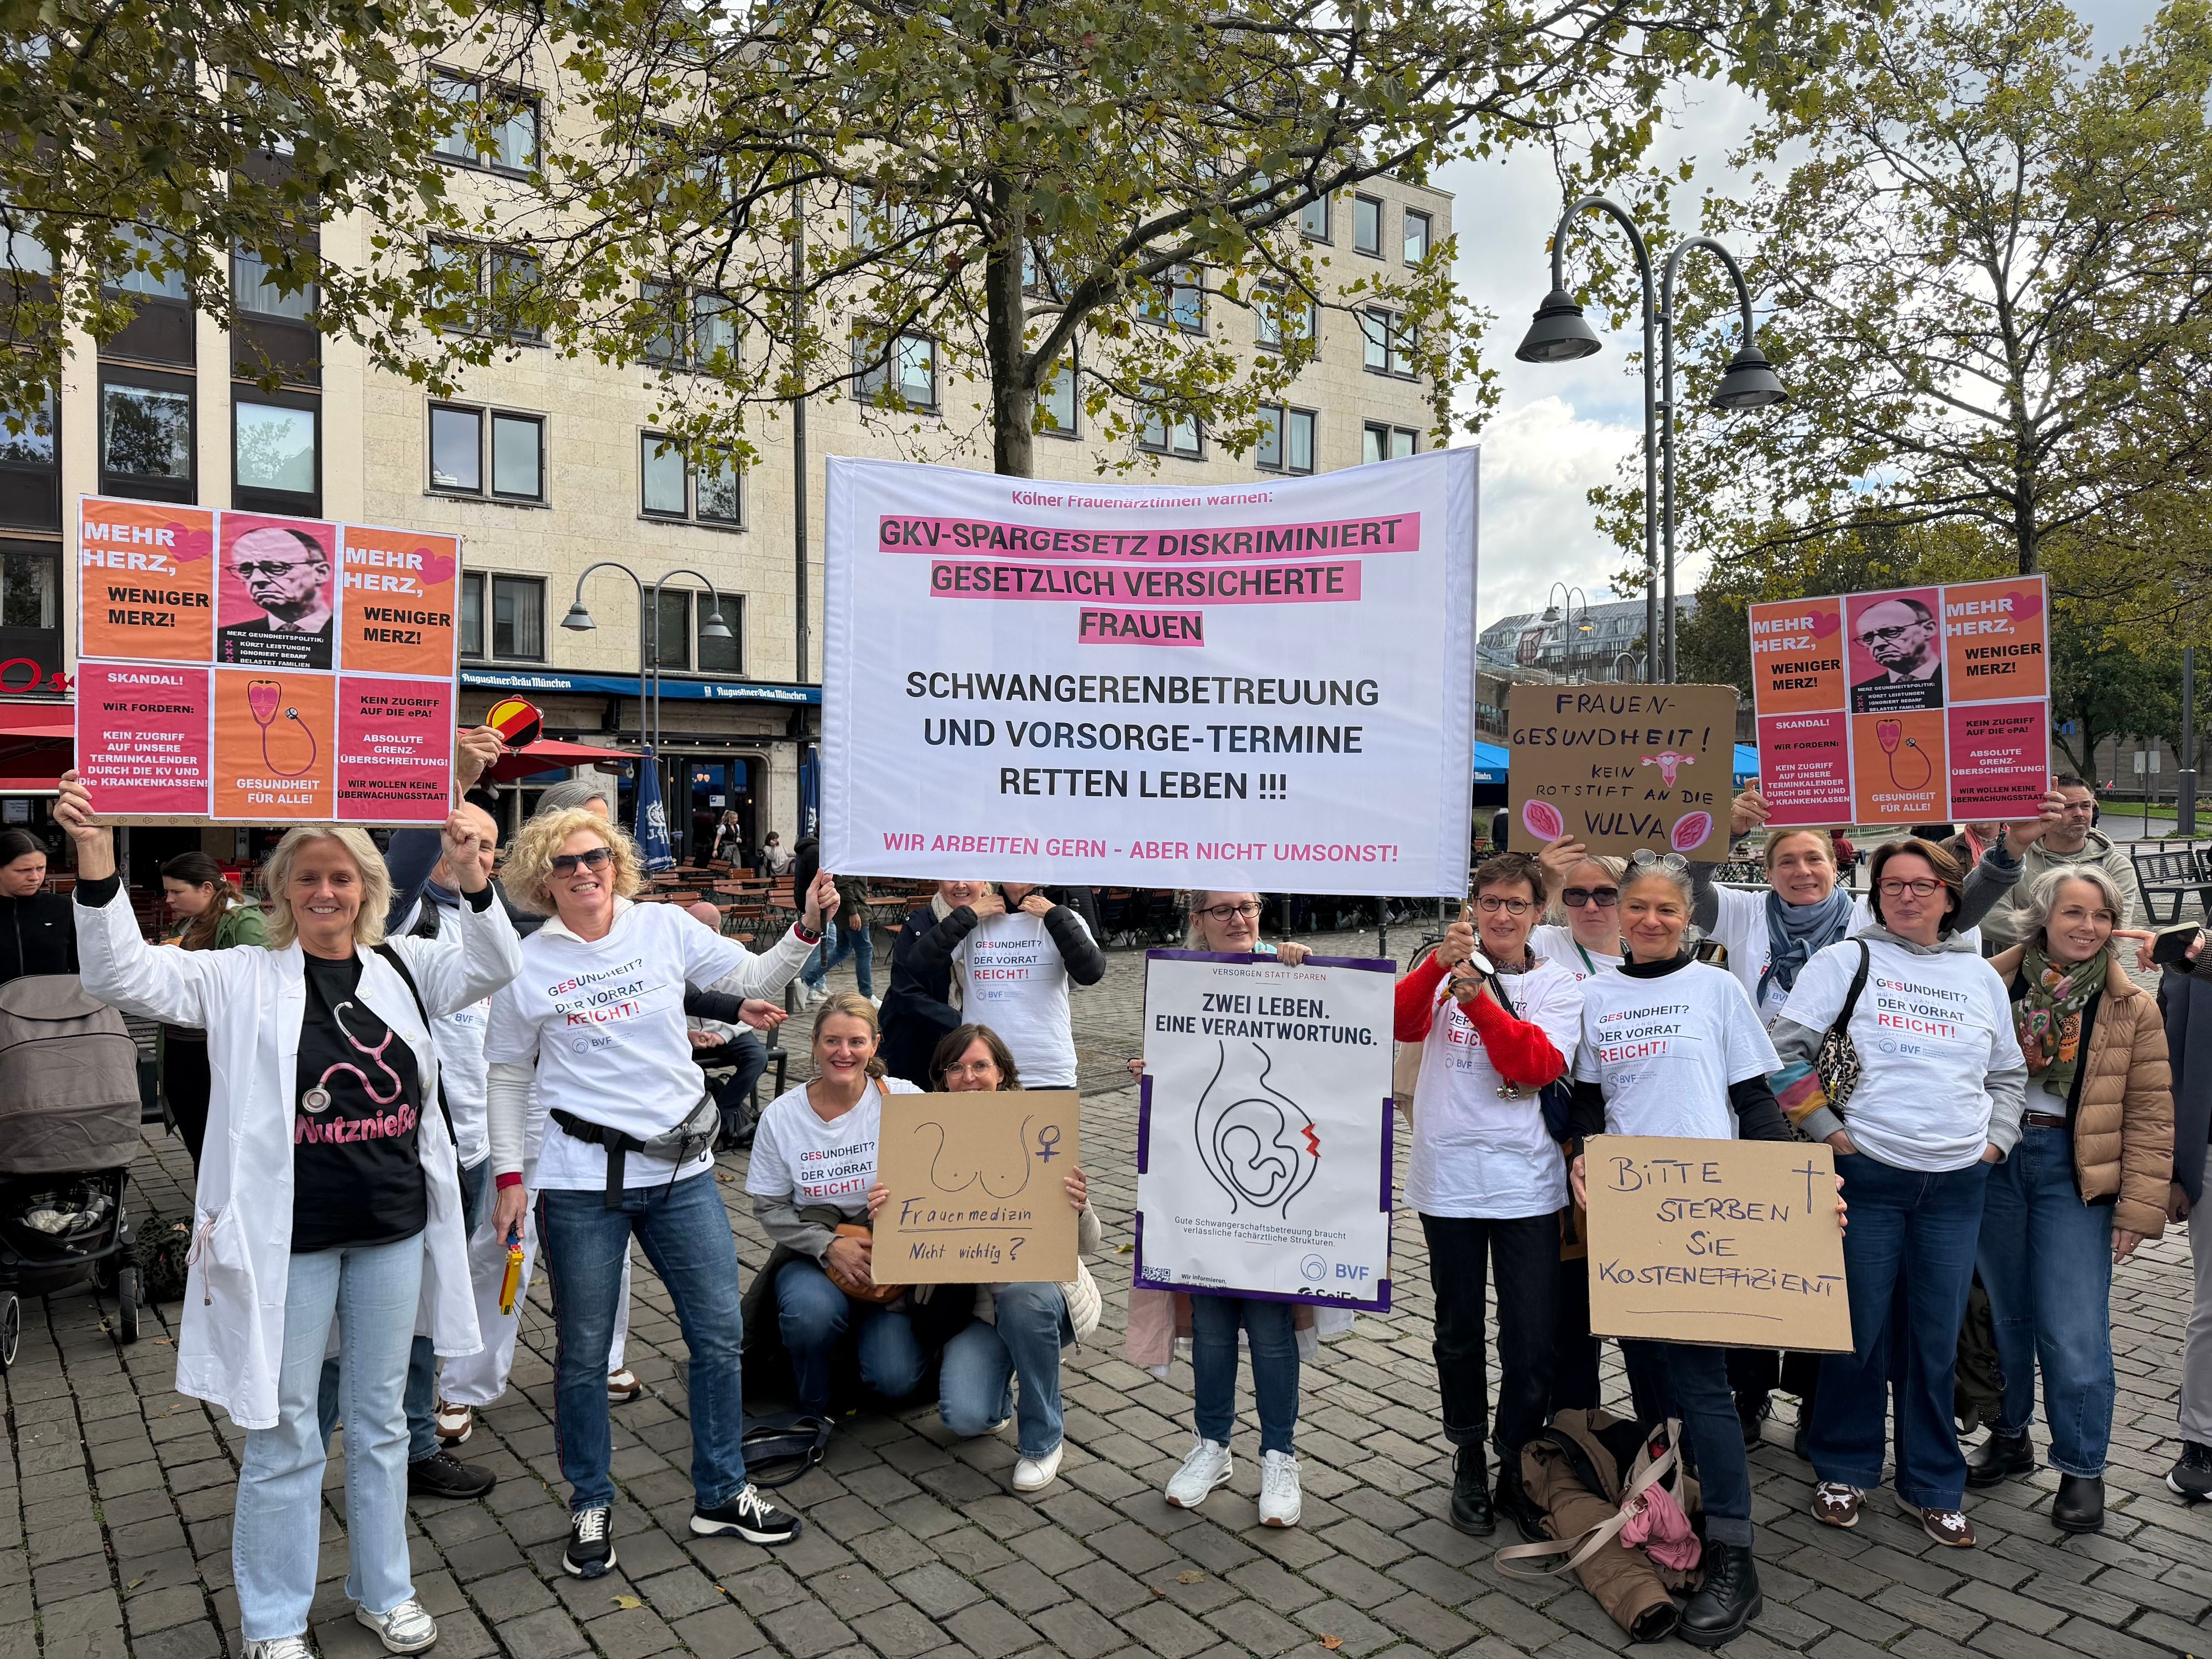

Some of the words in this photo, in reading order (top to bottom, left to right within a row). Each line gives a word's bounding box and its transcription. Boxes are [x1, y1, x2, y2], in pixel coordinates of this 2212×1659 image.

[1011, 490, 1063, 507] Kölner
[1068, 495, 1201, 509] Frauenärztinnen
[1207, 492, 1273, 505] warnen:
[84, 521, 175, 547] MEHR
[880, 520, 1149, 556] GKV-SPARGESETZ
[1158, 519, 1402, 557] DISKRIMINIERT
[83, 549, 176, 576] HERZ,
[346, 547, 423, 571] MEHR
[343, 573, 423, 597] HERZ,
[931, 565, 1114, 596] GESETZLICH
[1124, 566, 1344, 597] VERSICHERTE
[108, 586, 209, 608] WENIGER
[1947, 598, 2013, 617] MEHR
[108, 609, 175, 627] MERZ!
[364, 607, 451, 627] WENIGER
[1754, 615, 1814, 634] MEHR
[1080, 612, 1201, 640] FRAUEN
[1947, 619, 2015, 637] HERZ,
[249, 632, 324, 643] GEUNDHEITSPOLITIK:
[363, 628, 421, 645] MERZ!
[1754, 635, 1816, 653] HERZ,
[266, 643, 311, 651] LEISTUNGEN
[1965, 643, 2042, 660] WENIGER
[1771, 659, 1840, 675] WENIGER
[1966, 662, 2016, 677] MERZ!
[107, 672, 183, 685] SKANDAL!
[531, 677, 571, 688] München
[1772, 677, 1818, 691] MERZ!
[775, 689, 807, 701] München
[906, 671, 1379, 706] SCHWANGERENBETREUUNG
[131, 703, 194, 713] FORDERN:
[391, 697, 440, 707] ZUGRIFF
[1556, 693, 1675, 714] FRAUEN-
[1776, 719, 1829, 729] SKANDAL!
[1992, 717, 2035, 726] ZUGRIFF
[103, 731, 132, 740] KEIN
[135, 732, 185, 741] ZUGRIFF
[363, 734, 424, 744] ABSOLUTE
[925, 718, 995, 747] UND
[1005, 721, 1363, 754] VORSORGE-TERMINE
[134, 744, 181, 752] UNSERE
[374, 746, 416, 754] GRENZ-
[90, 754, 197, 764] TERMINKALENDER
[340, 754, 448, 766] ÜBERSCHREITUNG!
[88, 765, 129, 774] DURCH
[133, 766, 152, 775] DIE
[175, 768, 199, 776] UND
[1592, 764, 1635, 779] KEIN
[101, 778, 208, 787] KRANKENKASSEN!
[236, 778, 320, 791] GESUNDHEIT
[368, 780, 406, 789] WOLLEN
[1000, 767, 1128, 797] RETTEN
[1140, 770, 1247, 800] LEBEN
[1767, 779, 1844, 789] TERMINKALENDER
[247, 792, 274, 804] FÜR
[277, 792, 312, 805] ALLE!
[337, 790, 447, 800] ÜBERWACHUNGSSTAAT!
[1536, 785, 1634, 797] ROTSTIFT
[1644, 789, 1670, 801] AN
[1682, 790, 1713, 805] DIE
[1871, 792, 1936, 803] GESUNDHEIT
[1880, 802, 1903, 813] FÜR
[1906, 801, 1931, 812] ALLE!
[1585, 810, 1665, 839] VULVA
[883, 832, 925, 851] WIR
[931, 834, 1039, 855] ARBEITEN
[1046, 838, 1107, 858] GERN
[1129, 840, 1189, 859] ABER
[1197, 842, 1266, 860] NICHT
[1274, 843, 1399, 863] UMSONST!
[975, 940, 1041, 948] GESUNDHEIT?
[997, 956, 1037, 964] VORRAT
[548, 959, 642, 996] GESUNDHEIT?
[974, 969, 1029, 980] REICHT!
[1212, 968, 1261, 978] VERSORGEN
[1264, 971, 1291, 979] STATT
[1293, 972, 1326, 982] SPAREN
[555, 1001, 585, 1014] DER
[587, 980, 644, 1006] VORRAT
[1876, 978, 1968, 1003] GESUNDHEIT?
[567, 1001, 640, 1026] REICHT!
[1202, 993, 1251, 1015] ZWEI
[1258, 996, 1330, 1020] LEBEN.
[1599, 1005, 1689, 1024] GESUNDHEIT?
[1877, 998, 1906, 1010] DER
[1909, 1003, 1965, 1022] VORRAT
[455, 1013, 473, 1024] BVF
[1878, 1013, 1956, 1039] REICHT!
[1155, 1014, 1196, 1034] EINE
[1201, 1018, 1378, 1046] VERANTWORTUNG.
[1626, 1025, 1681, 1039] VORRAT
[592, 1036, 612, 1046] BVF
[1900, 1044, 1921, 1054] BVF
[1600, 1041, 1666, 1062] REICHT!
[1457, 1059, 1472, 1069] BVF
[1620, 1074, 1636, 1083] BVF
[801, 1141, 875, 1161] GESUNDHEIT?
[802, 1170, 825, 1181] DER
[827, 1161, 873, 1177] VORRAT
[804, 1178, 865, 1197] REICHT!
[899, 1197, 1031, 1226] Frauenmedizin
[1656, 1197, 1789, 1223] STERBEN
[1175, 1216, 1193, 1225] Gute
[1195, 1218, 1312, 1237] Schwangerschaftsbetreuung
[1314, 1229, 1346, 1239] braucht
[1183, 1226, 1232, 1237] verlässliche
[1234, 1229, 1287, 1242] fachärztliche
[1290, 1236, 1335, 1247] Strukturen.
[1192, 1274, 1227, 1285] informieren,
[1335, 1263, 1369, 1281] BVF
